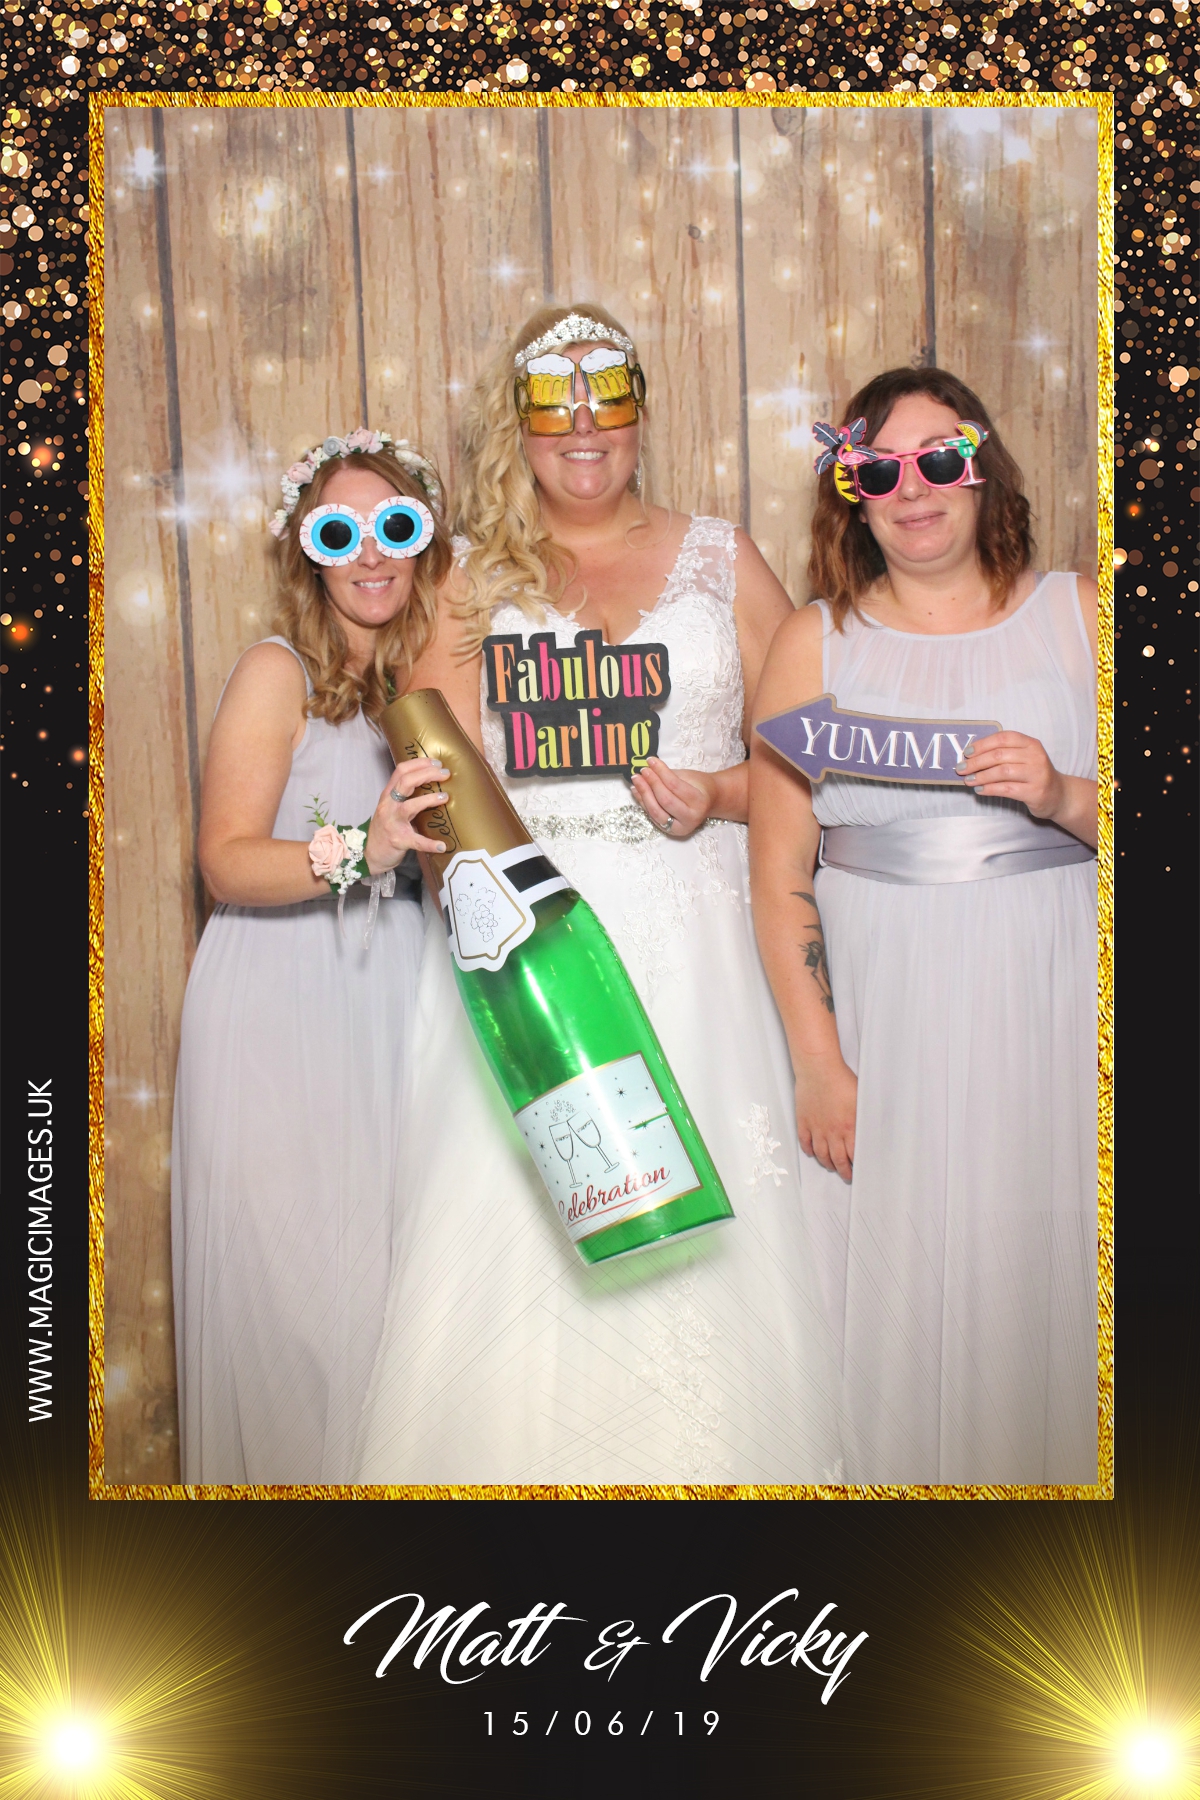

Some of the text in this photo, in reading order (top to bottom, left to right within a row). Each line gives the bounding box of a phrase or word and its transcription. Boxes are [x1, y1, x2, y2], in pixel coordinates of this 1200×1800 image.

[491, 639, 663, 703] Fabulous
[509, 707, 652, 775] Darling
[800, 716, 977, 770] YUMMY
[558, 1166, 671, 1226] Celebration
